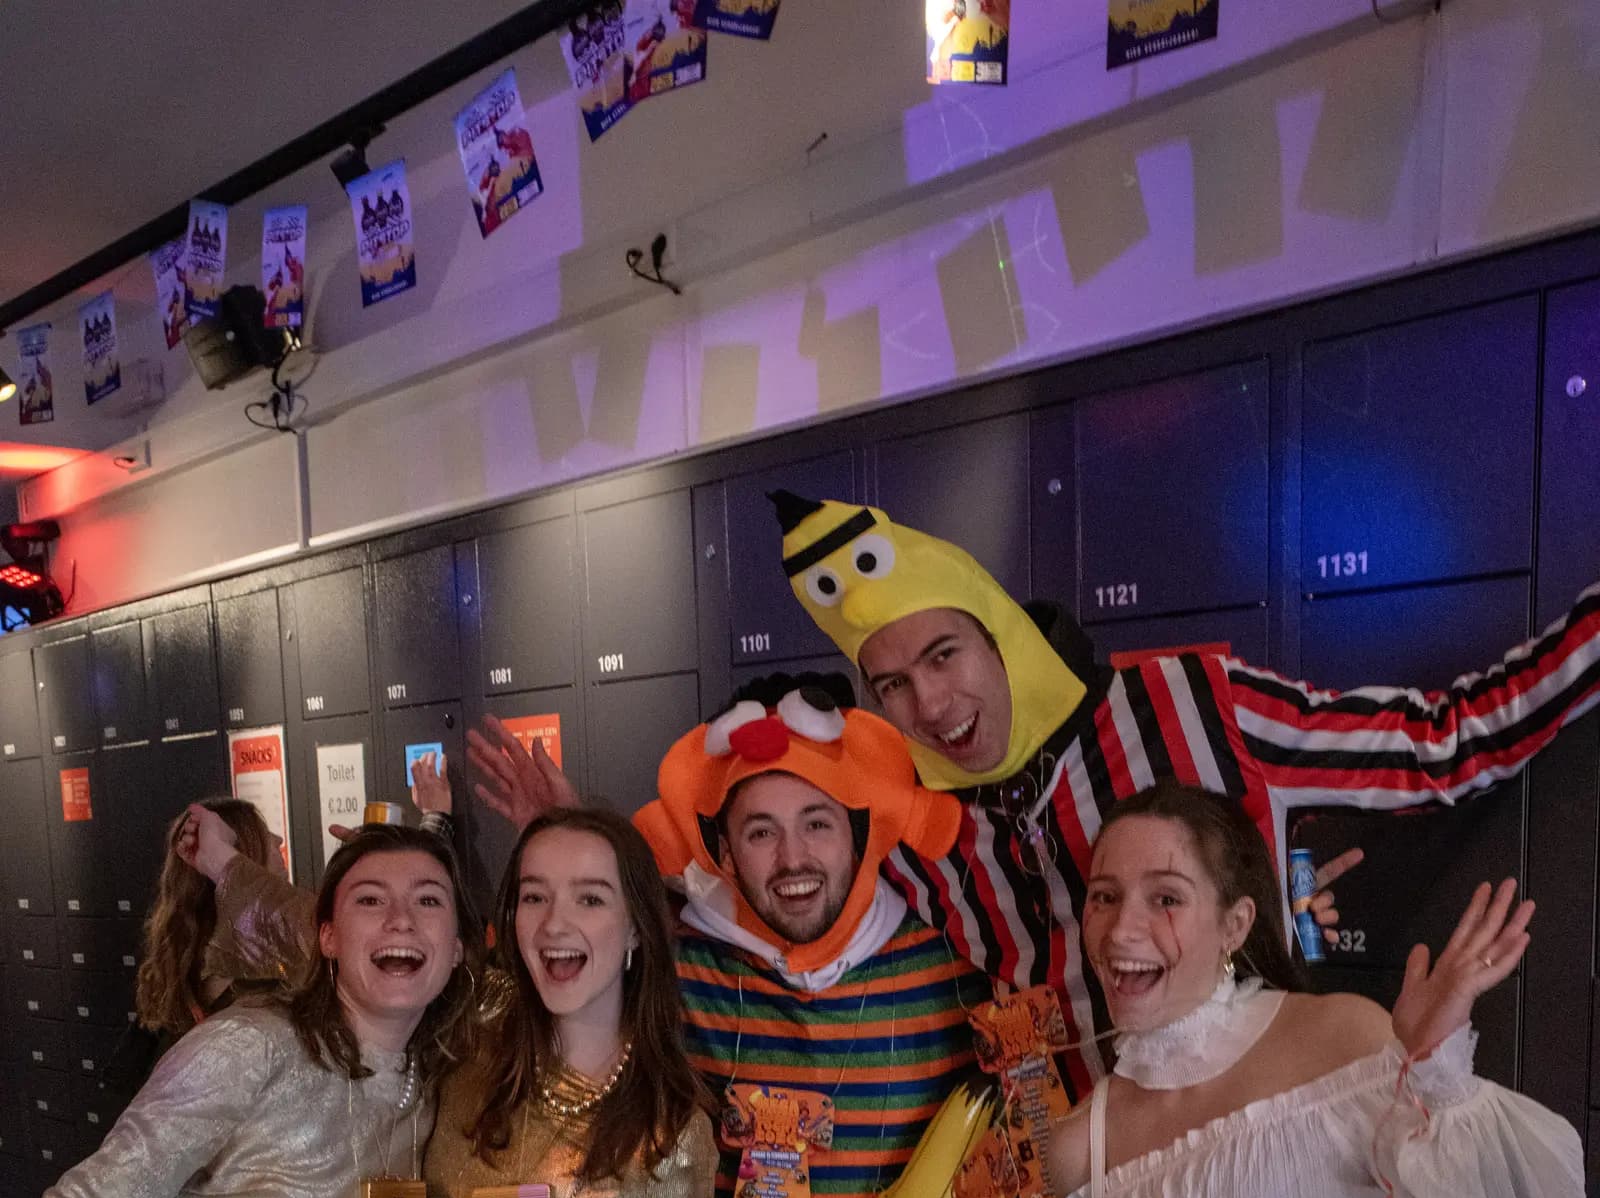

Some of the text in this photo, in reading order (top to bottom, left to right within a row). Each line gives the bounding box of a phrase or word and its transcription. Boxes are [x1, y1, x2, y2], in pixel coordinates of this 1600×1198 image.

[1317, 550, 1368, 578] 1131
[1095, 582, 1138, 608] 1121
[740, 633, 771, 653] 1101
[598, 653, 624, 673] 1091
[490, 667, 512, 685] 1081
[387, 684, 407, 700] 1071
[307, 696, 324, 711] 1061
[240, 747, 272, 767] SNACKS
[327, 764, 356, 782] Toilet
[336, 797, 358, 814] 2.00
[1329, 930, 1366, 953] 32
